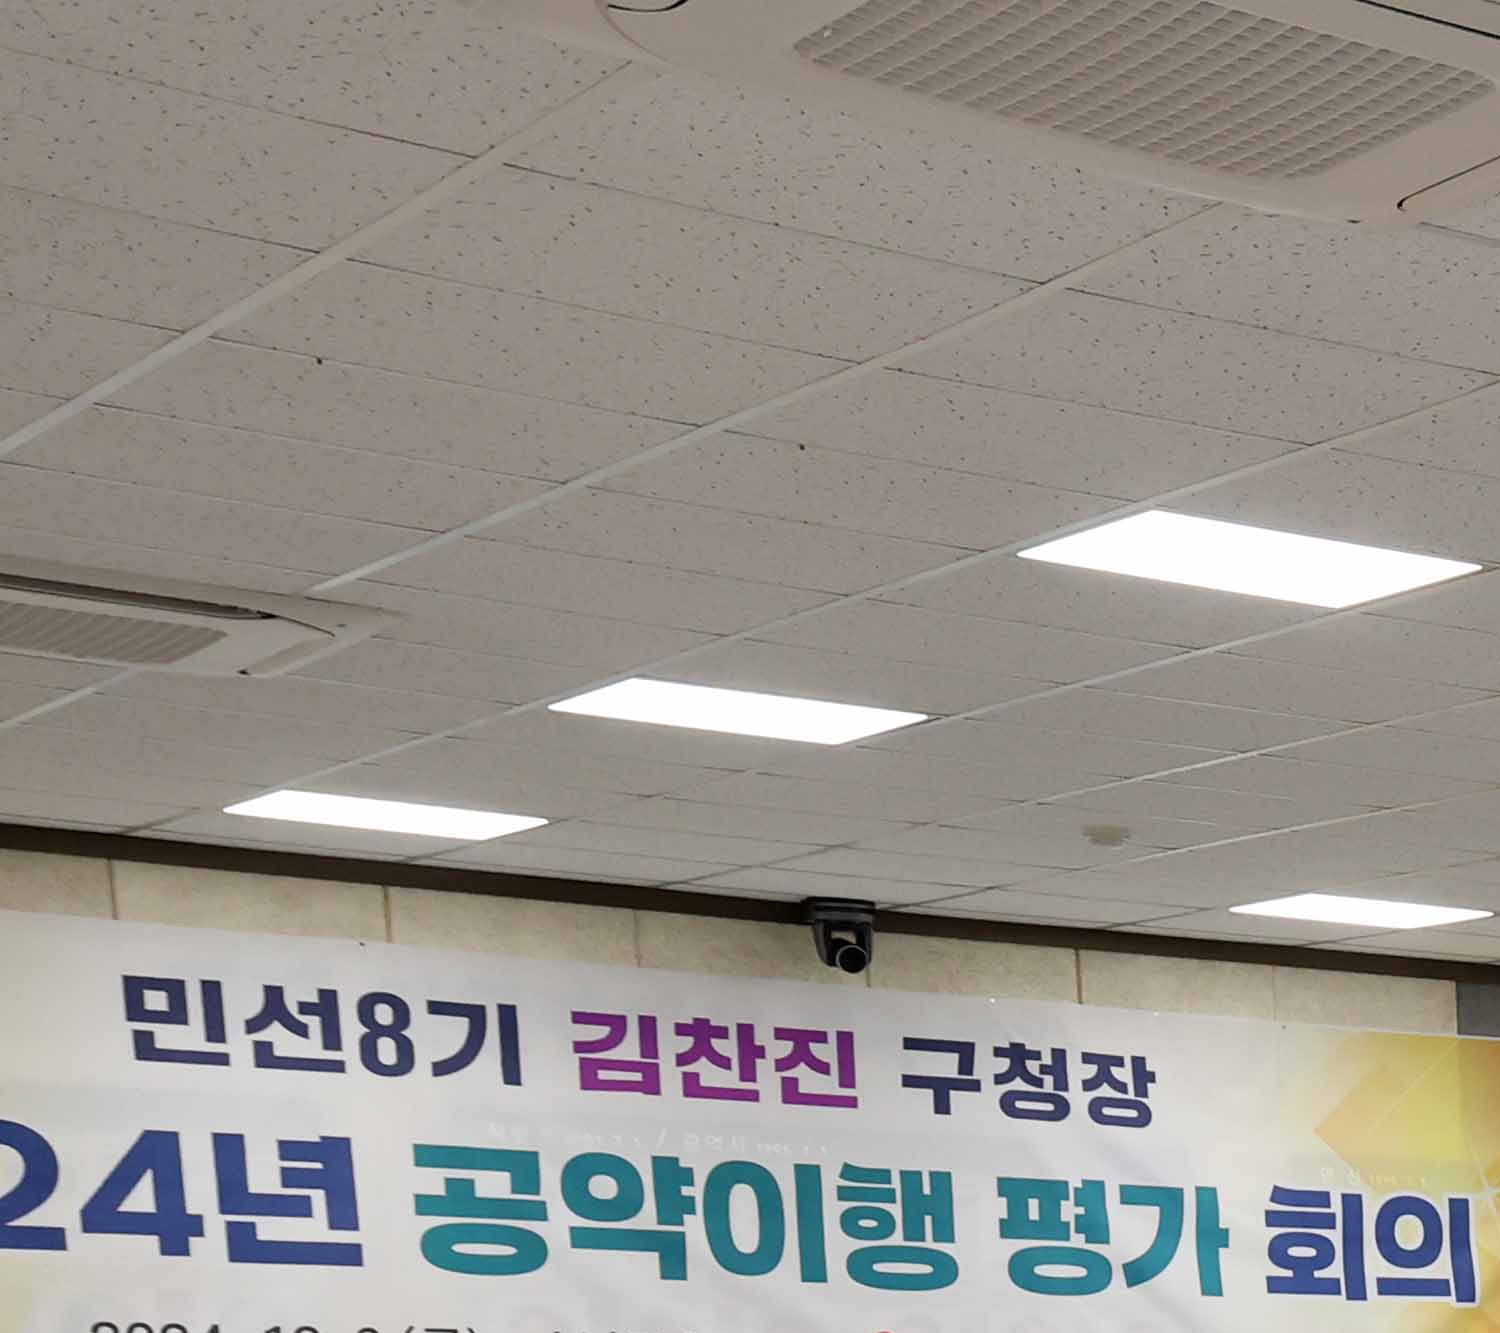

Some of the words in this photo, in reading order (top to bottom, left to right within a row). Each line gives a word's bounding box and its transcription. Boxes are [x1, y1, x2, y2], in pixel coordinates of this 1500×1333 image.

[122, 974, 523, 1087] 민선8기
[570, 1010, 859, 1109] 김찬진
[901, 1036, 1157, 1129] 구청장
[413, 1143, 959, 1292] 공약이행
[996, 1176, 1230, 1297] 평가
[1264, 1184, 1477, 1303] 회의
